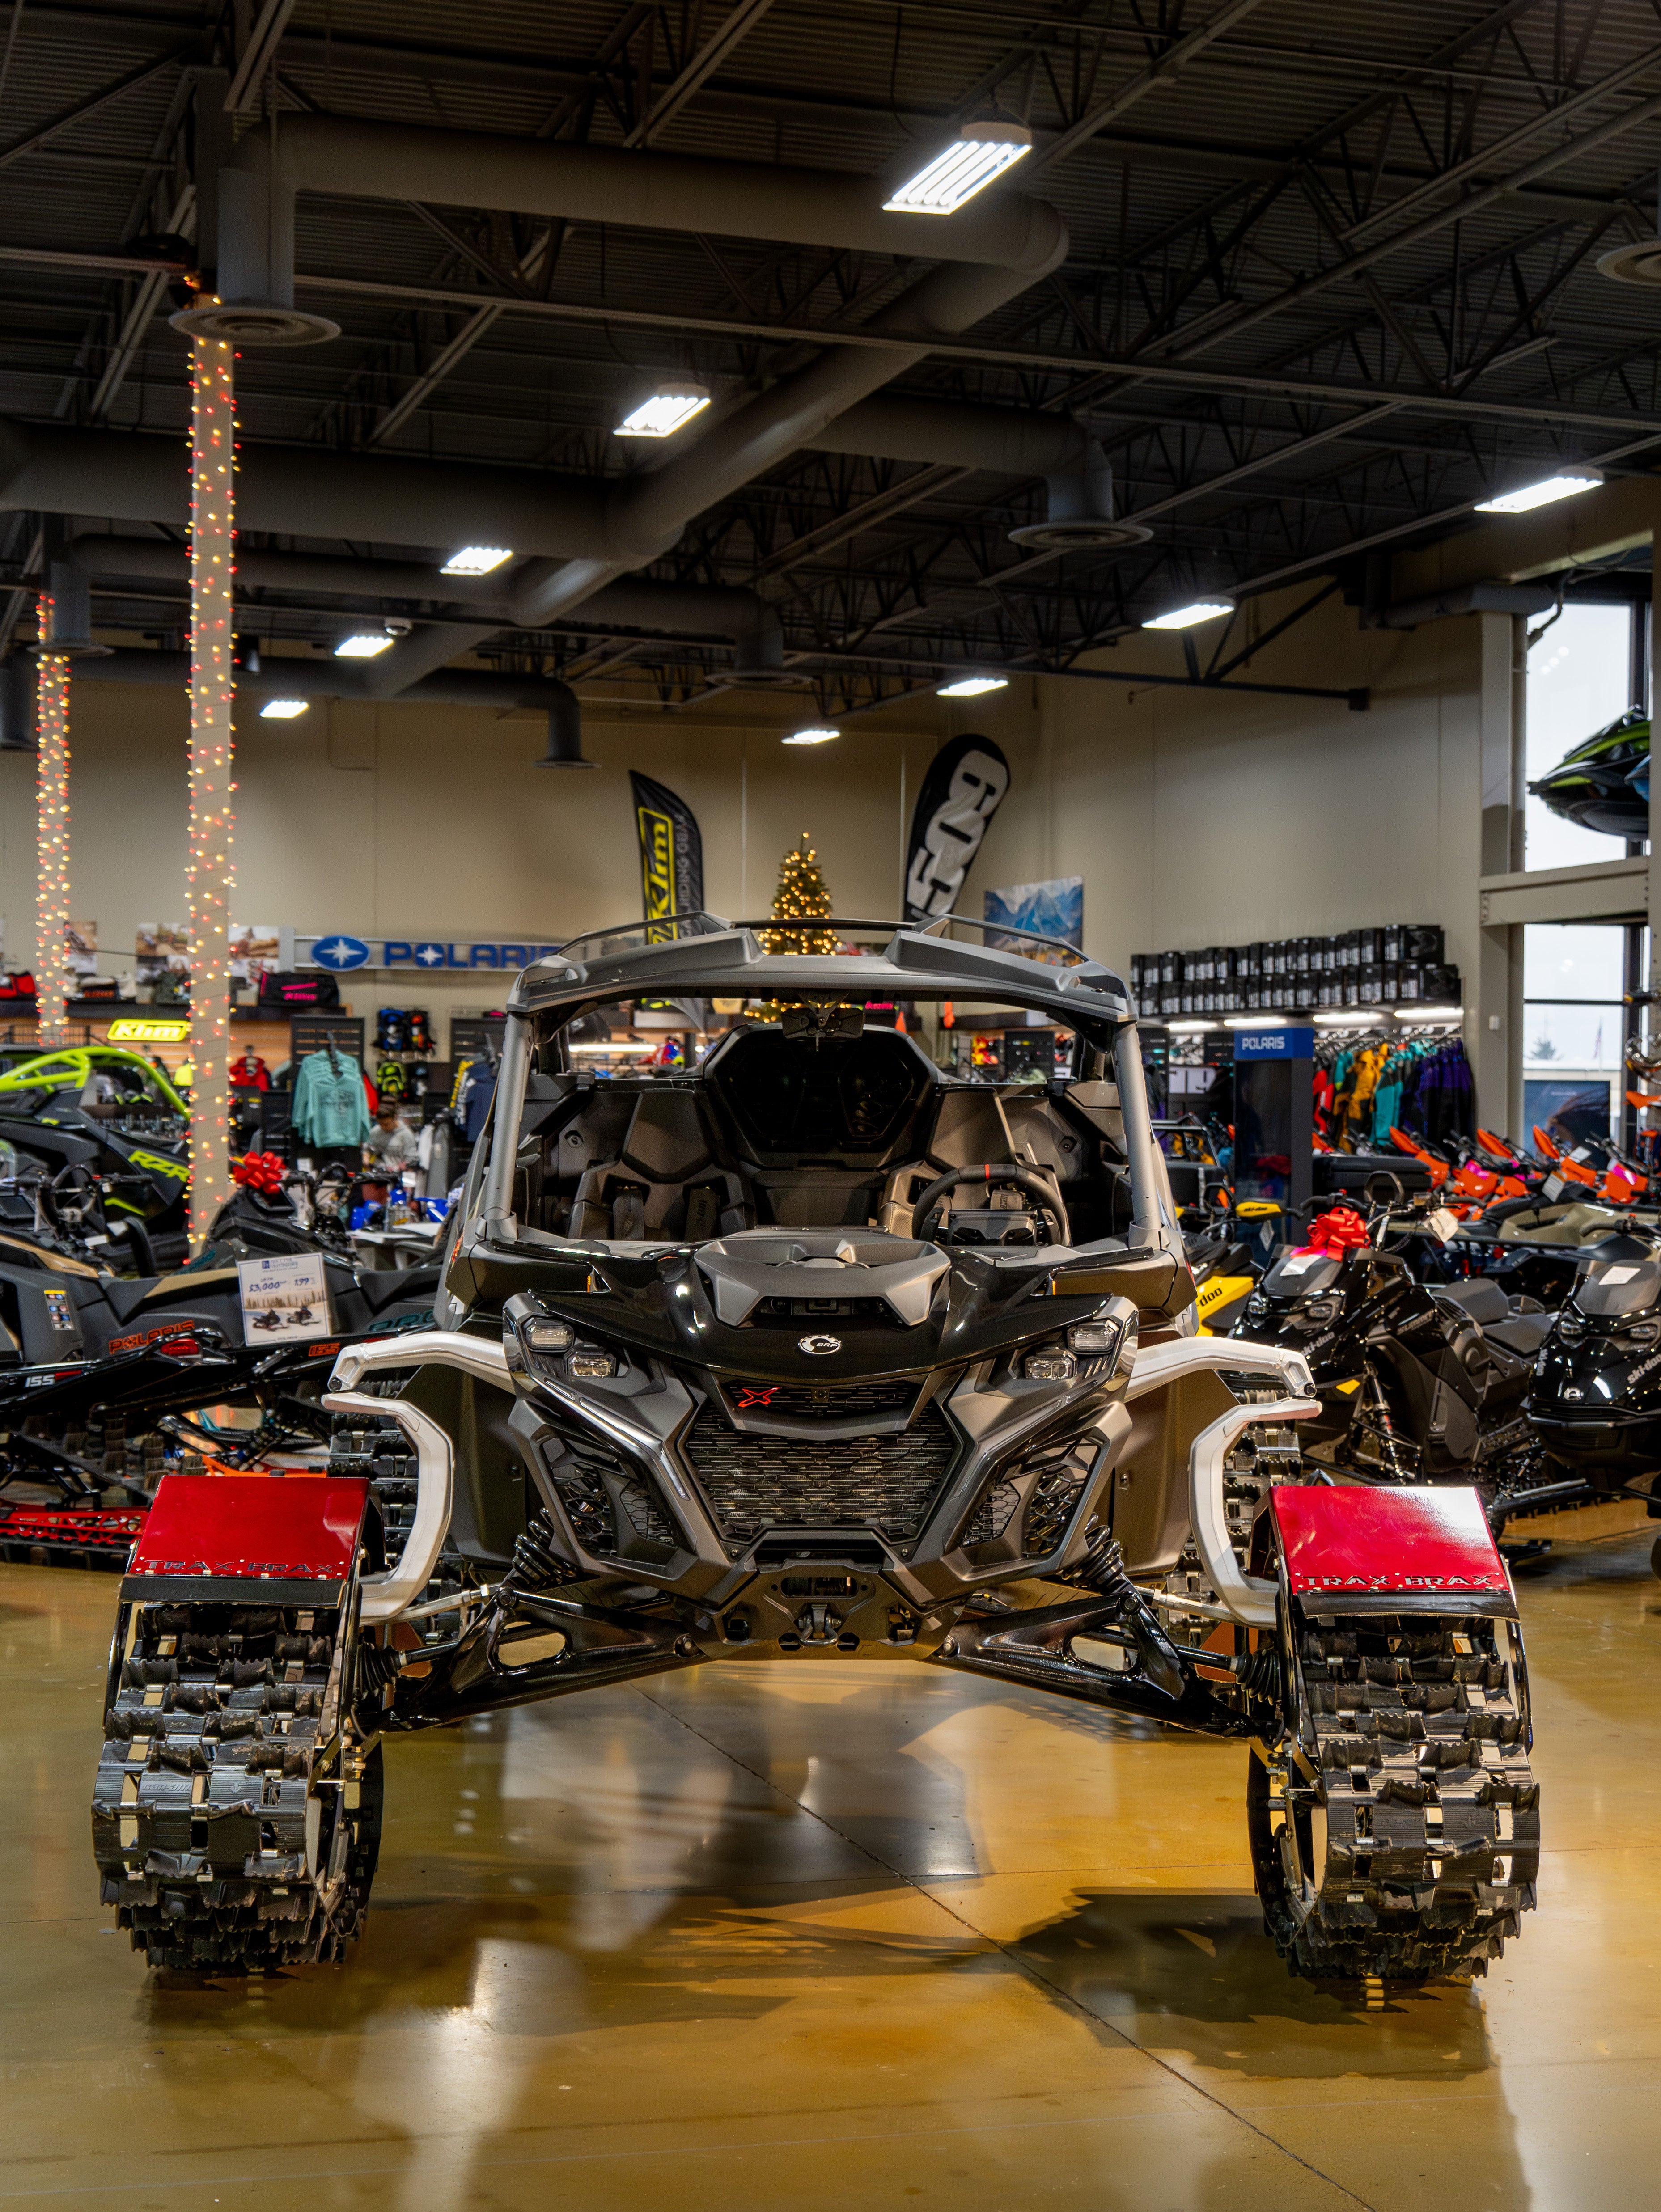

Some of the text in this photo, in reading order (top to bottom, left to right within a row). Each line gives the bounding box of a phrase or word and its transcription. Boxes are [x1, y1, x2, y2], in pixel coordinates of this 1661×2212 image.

[907, 749, 1008, 915] 509
[1242, 1036, 1285, 1050] POLARIS
[128, 1150, 190, 1183] RZR
[1196, 1288, 1223, 1307] -doo
[25, 1374, 55, 1388] 155
[144, 1560, 336, 1573] TRAX BRAX
[1302, 1575, 1492, 1585] TRAX BRAX
